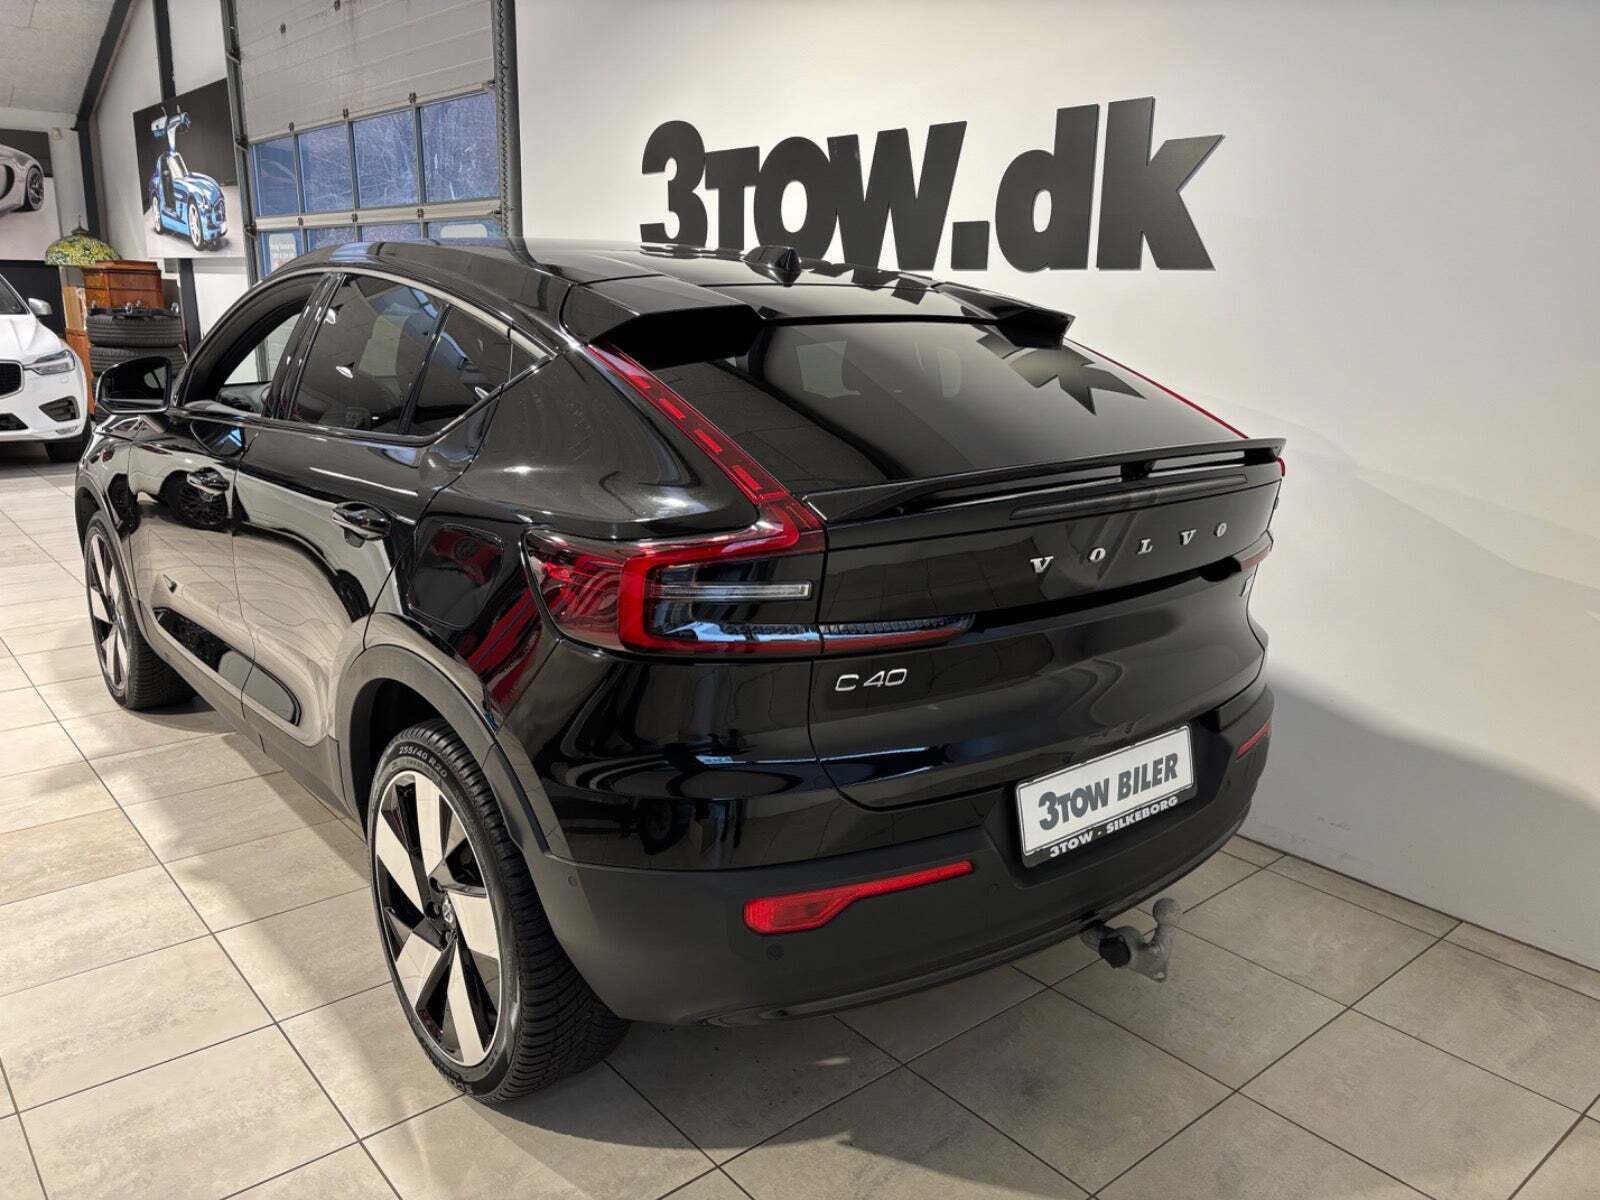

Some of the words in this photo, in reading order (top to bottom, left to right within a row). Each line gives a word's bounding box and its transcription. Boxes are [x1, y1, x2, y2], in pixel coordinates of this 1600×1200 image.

[1030, 522, 1228, 574] VOLVO
[1038, 777, 1110, 831] 3TOW
[1117, 753, 1178, 801] BILER
[1049, 831, 1094, 858] 3TOW
[1106, 796, 1178, 834] SILKEBORG
